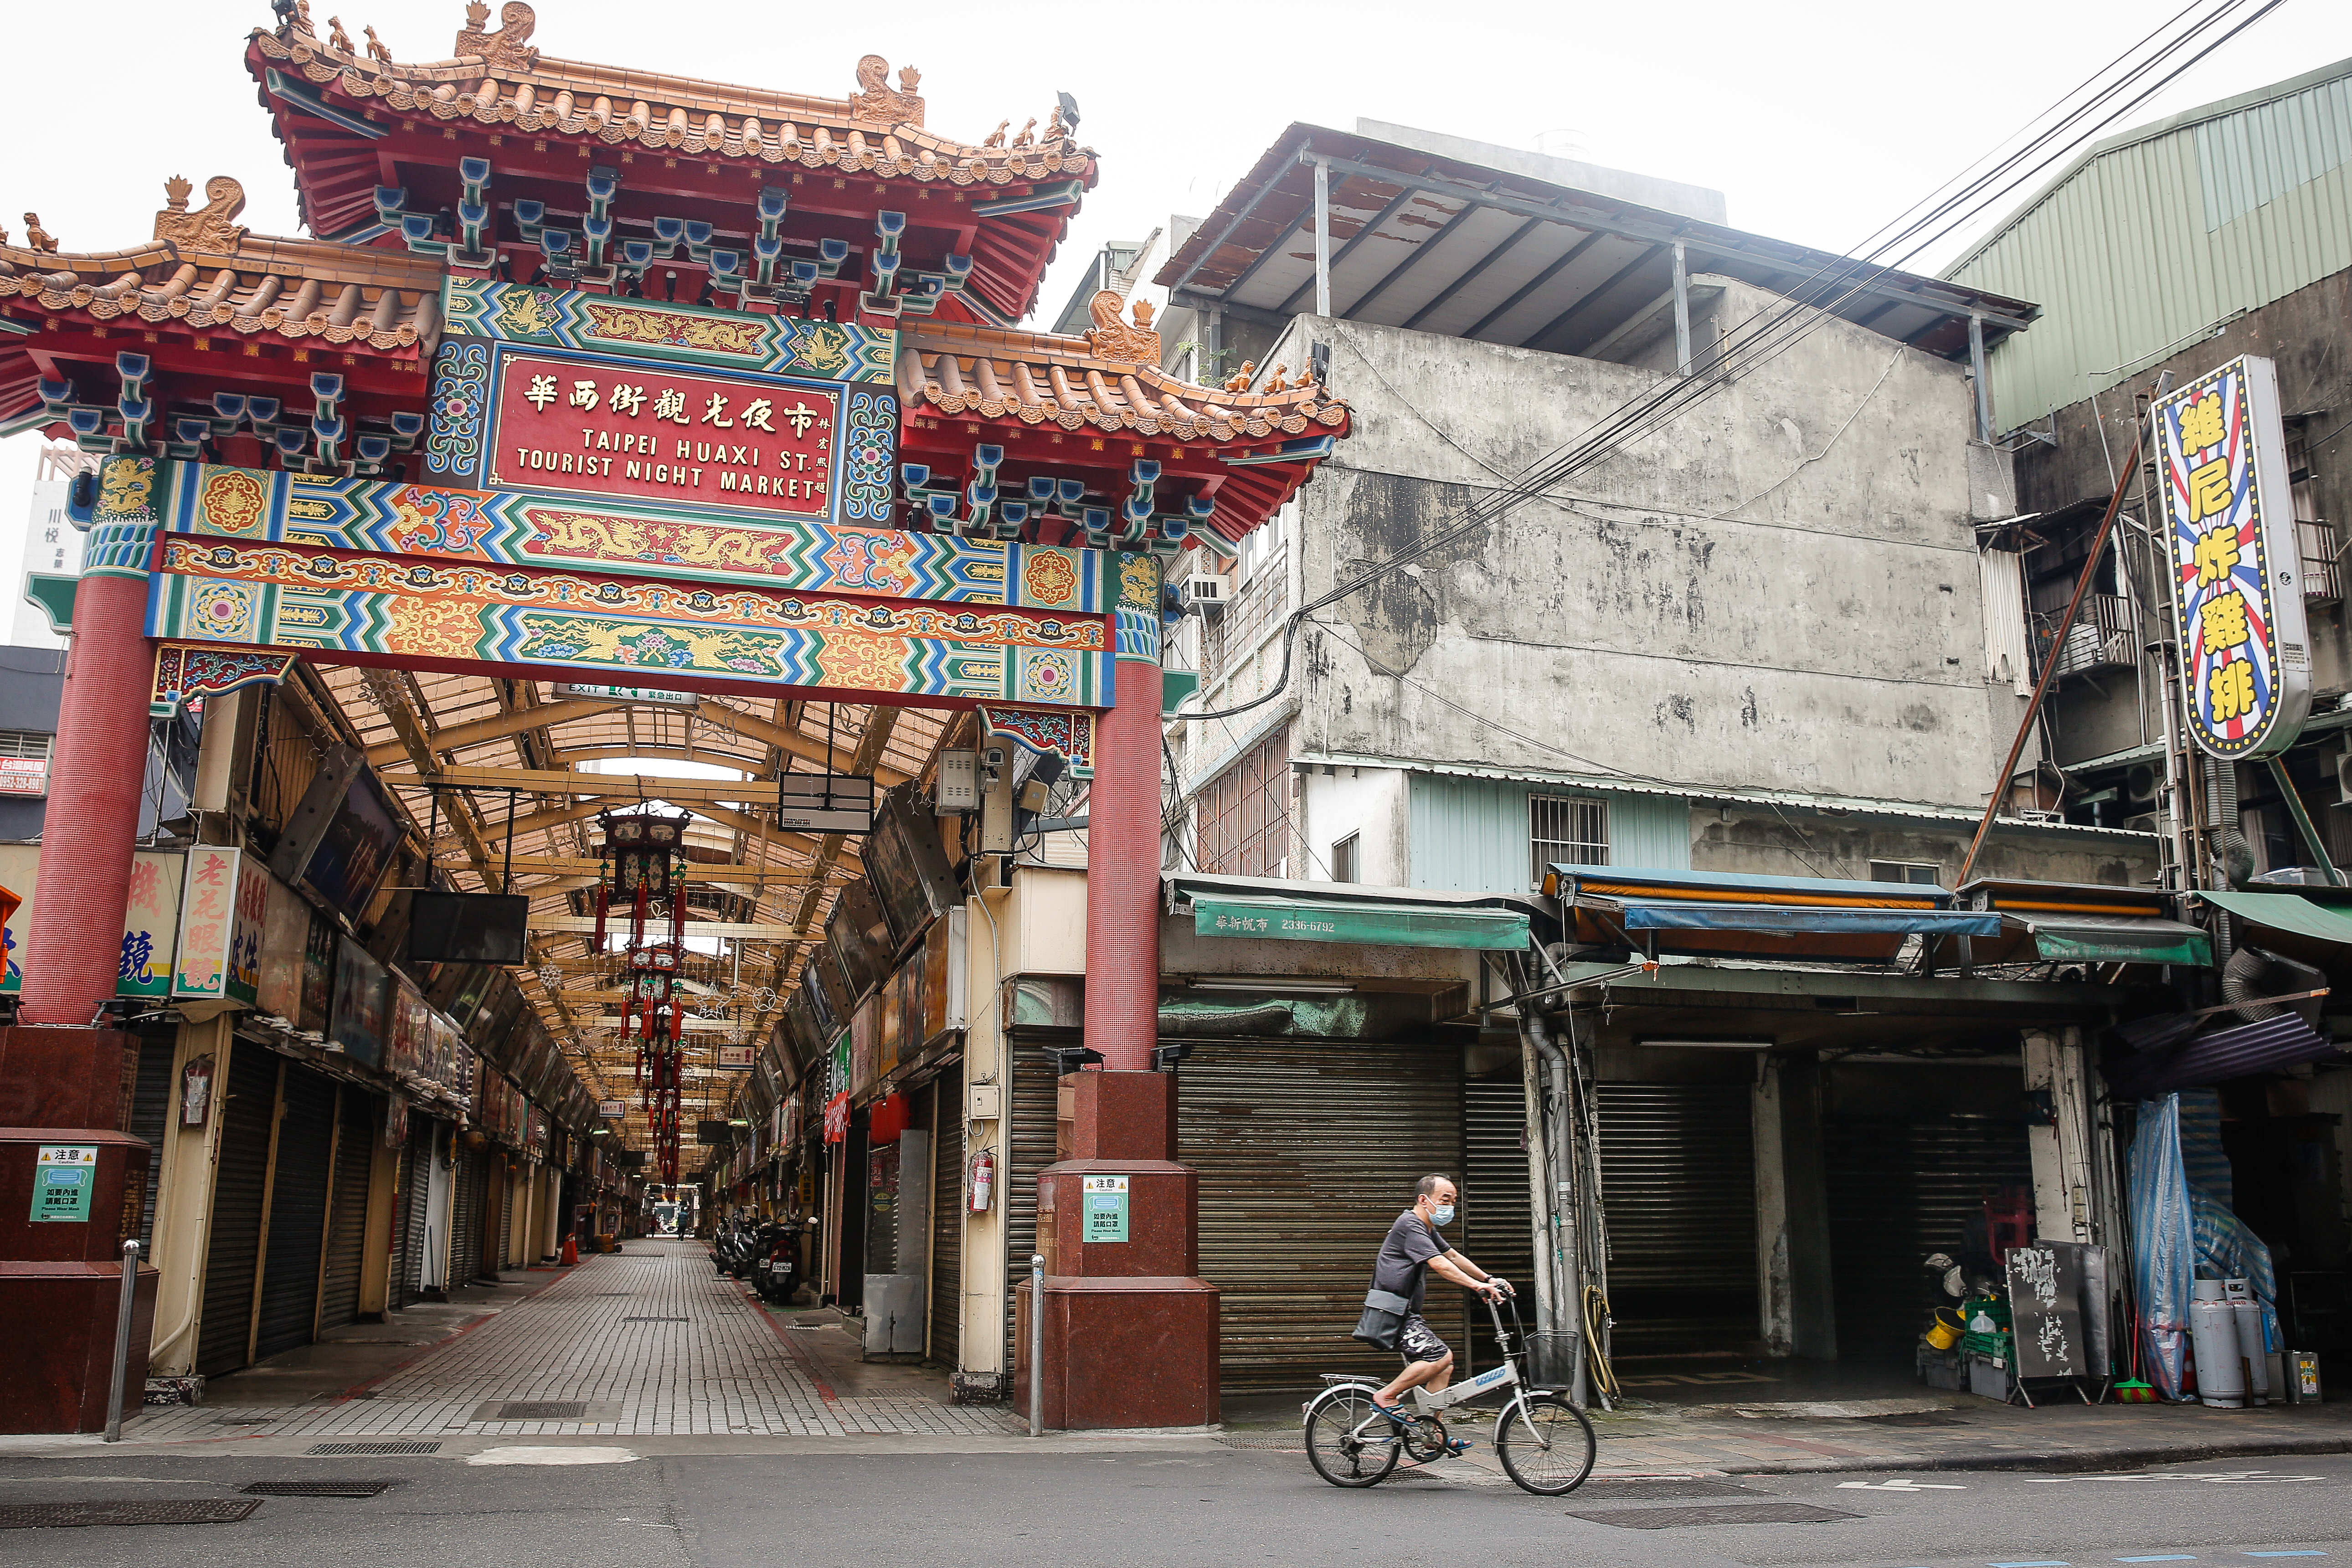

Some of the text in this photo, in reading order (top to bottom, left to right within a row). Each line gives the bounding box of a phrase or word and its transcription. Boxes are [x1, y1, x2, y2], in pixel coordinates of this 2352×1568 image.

[524, 374, 818, 439] 華西街觀光夜市
[582, 428, 812, 473] TAIPEI HUAXI ST.
[517, 448, 814, 499] TOURIST NIGHT MARKET
[2179, 391, 2258, 724] 維尼炸雞排
[569, 684, 599, 693] EXIT
[648, 691, 682, 701] 緊急出口
[183, 853, 227, 990] 老花眼鏡
[1282, 919, 1335, 933] 2336-6792
[55, 1149, 80, 1160] 注意
[1096, 1179, 1115, 1188] 注意
